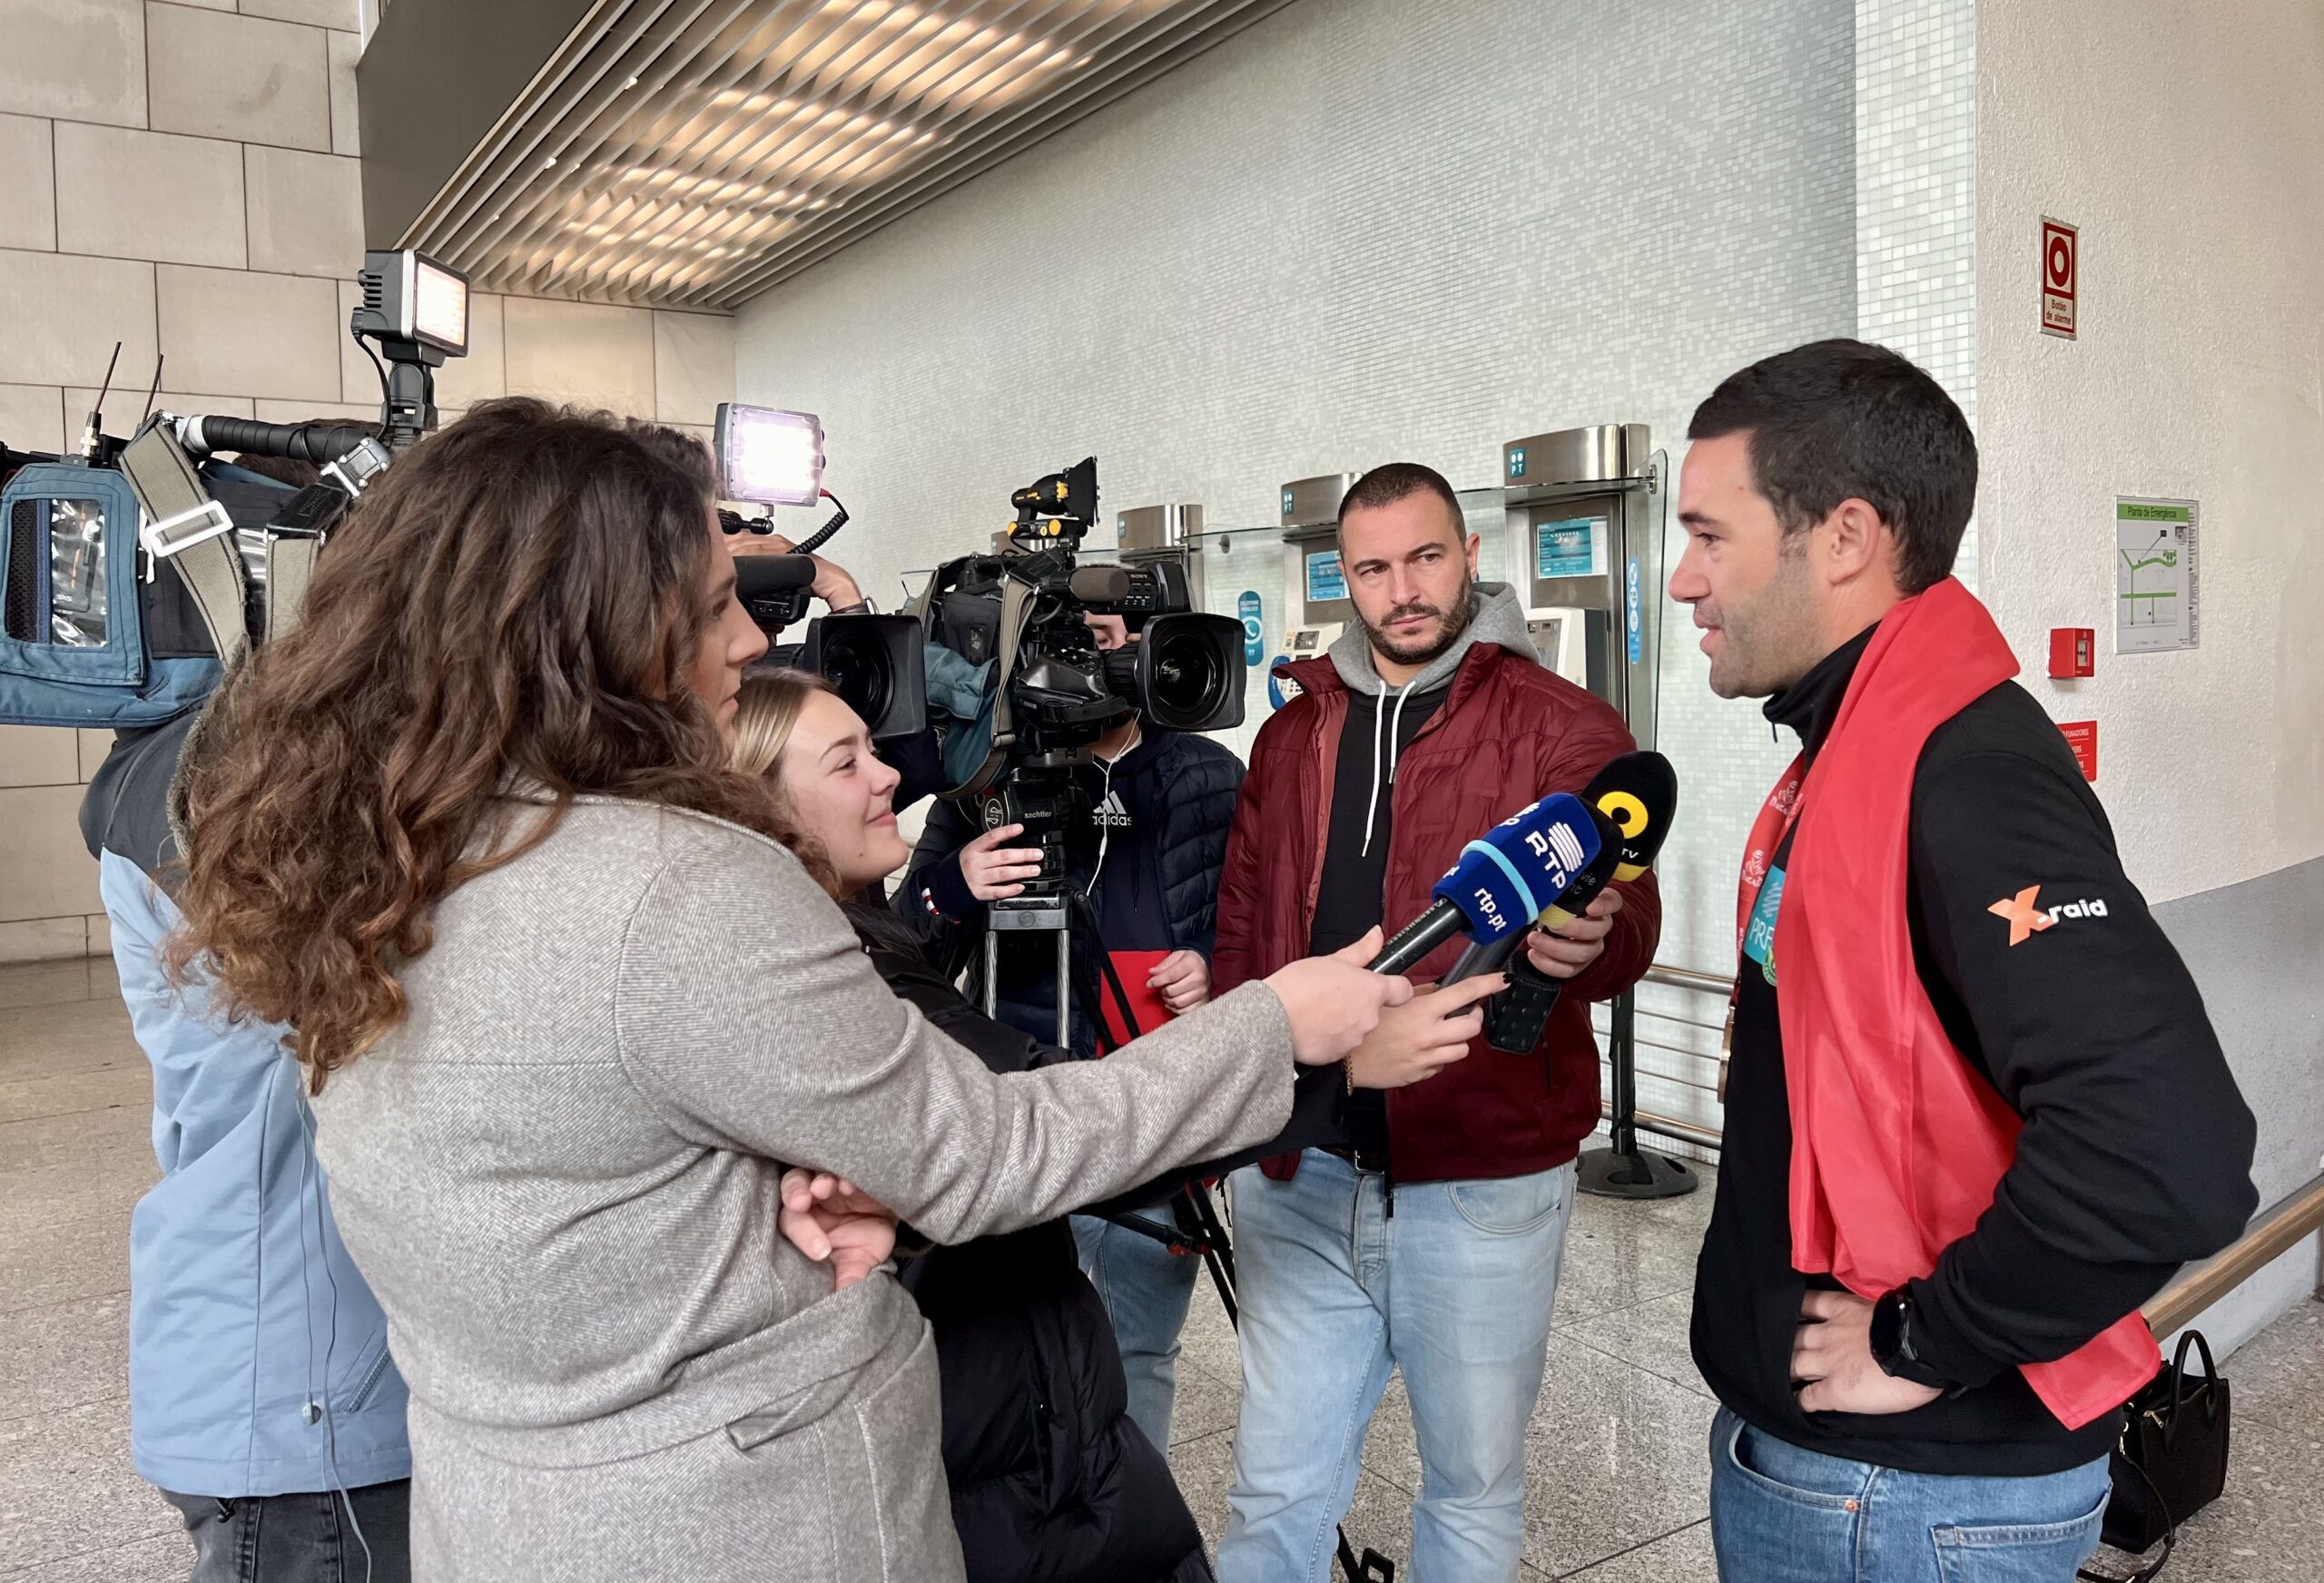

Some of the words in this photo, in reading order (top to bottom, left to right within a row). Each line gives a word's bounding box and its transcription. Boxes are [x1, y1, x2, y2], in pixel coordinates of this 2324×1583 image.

[2051, 299, 2067, 311] Botão
[2045, 310, 2053, 320] de
[2053, 313, 2072, 325] alarme
[1512, 463, 1523, 475] PT
[2127, 506, 2142, 517] Planta
[2143, 508, 2150, 517] de
[1024, 811, 1053, 820] sachtler
[1092, 813, 1133, 826] adidas
[1524, 830, 1567, 890] RTP
[1473, 888, 1508, 932] rtp.pt
